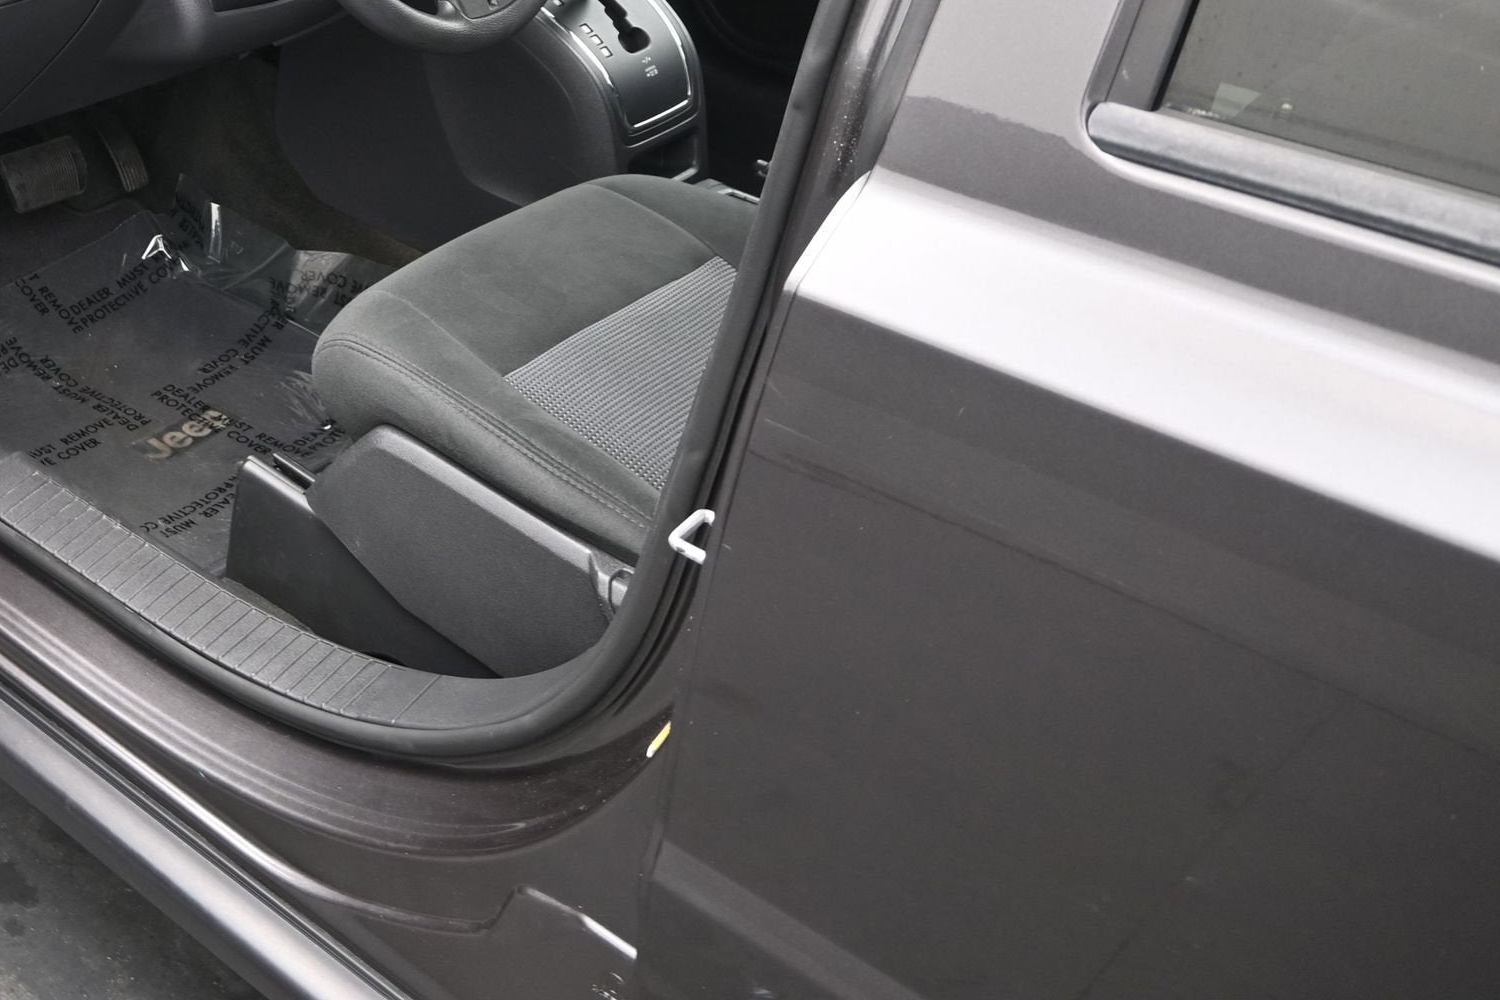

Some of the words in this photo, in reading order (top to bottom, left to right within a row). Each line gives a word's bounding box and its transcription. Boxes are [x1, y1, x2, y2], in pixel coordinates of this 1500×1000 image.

[71, 287, 114, 316] DEALER
[116, 261, 149, 289] MUST
[300, 270, 347, 288] COVER
[38, 286, 84, 334] REMOVE
[80, 281, 149, 329] PROTECTIVE
[6, 336, 53, 382] REMOVE
[197, 348, 239, 375] COVER
[240, 335, 273, 366] MUST
[39, 354, 79, 388] COVER
[52, 384, 87, 404] MUST
[80, 385, 152, 427] PROTECTIVE
[60, 417, 114, 446] REMOVE
[92, 404, 139, 432] DEALER
[146, 410, 230, 460] Jeep
[151, 390, 225, 435] PROTECTIVE
[227, 431, 273, 456] COVER
[163, 384, 212, 413] DEALER
[255, 432, 314, 458] REMOVE
[57, 437, 102, 461] COVER
[159, 481, 235, 526] PROTECTIVE
[160, 518, 198, 539] MUST
